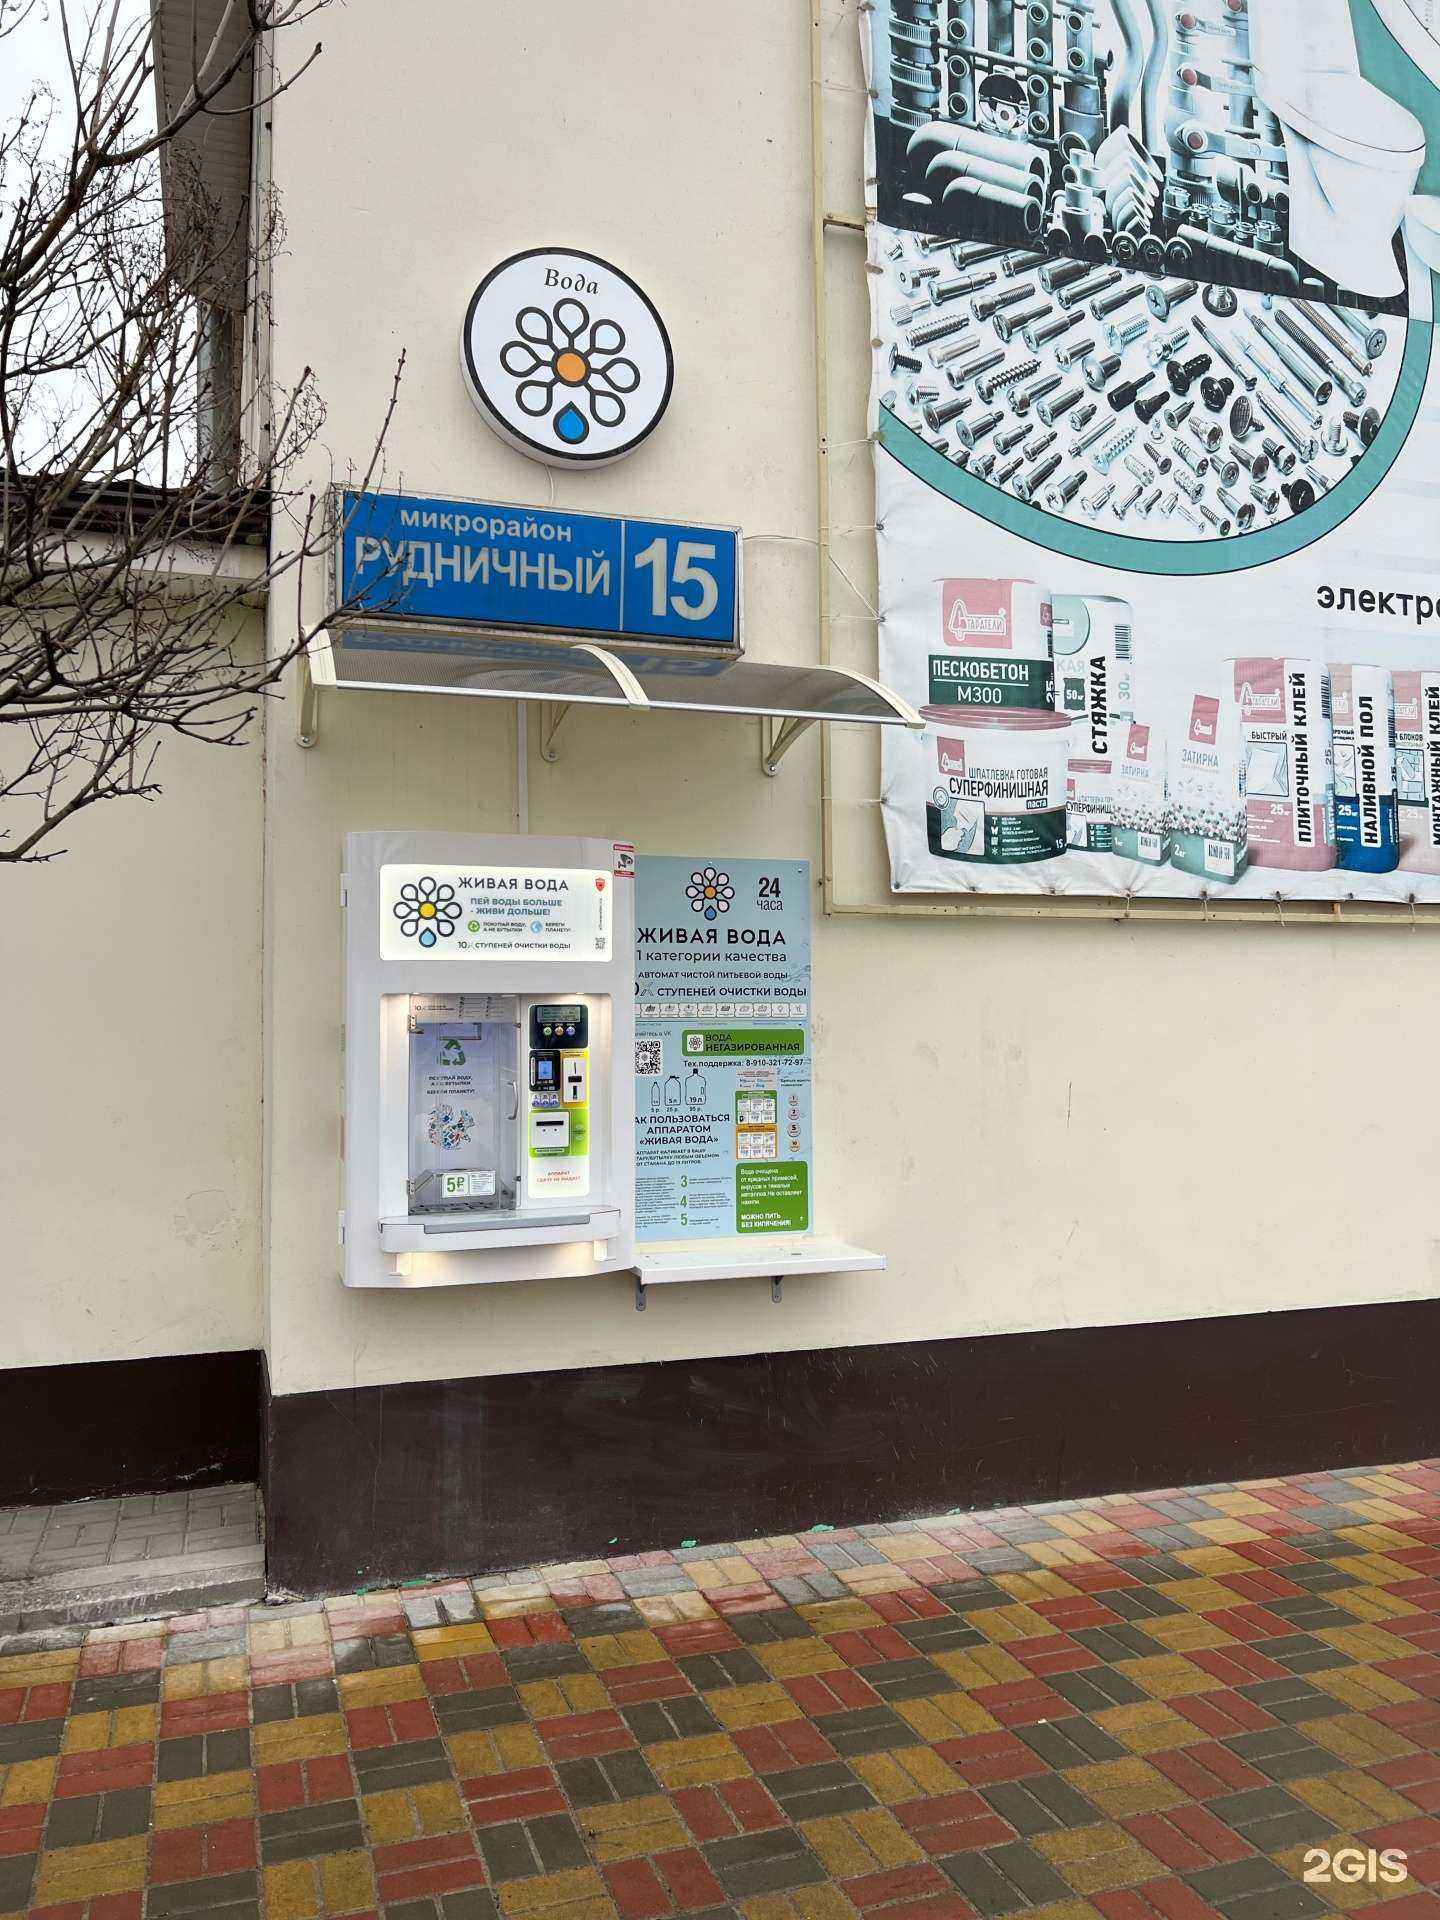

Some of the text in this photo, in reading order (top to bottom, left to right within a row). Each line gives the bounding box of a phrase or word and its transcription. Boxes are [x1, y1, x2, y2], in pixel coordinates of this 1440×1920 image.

[544, 267, 599, 295] Вода
[400, 508, 573, 543] микрорайон
[354, 536, 720, 622] РУДНИЧНЫЙ 15
[1317, 585, 1440, 625] электр
[932, 659, 1029, 681] ПЕСКОБЕТОН
[957, 685, 1002, 704] М300
[1089, 655, 1108, 754] СТЯЖКА
[1424, 686, 1440, 735] КЛЕЙ
[1251, 730, 1287, 741] БЫСТРЫЙ
[1289, 673, 1312, 843] ПЛИТОЧНЫЙ КЛЕЙ
[1016, 766, 1048, 780] ГОТОВАЯ
[1357, 696, 1378, 844] НАЛИВНОЙ ПОЛ
[949, 777, 1049, 799] СУПЕРФИНИШНАЯ
[458, 876, 569, 893] ЖИВАЯ ВОДА
[758, 877, 781, 898] 24
[470, 896, 563, 907] ПЕЙ ВОДЫ БОЛЬШЕ
[756, 899, 784, 911] часа
[476, 907, 505, 915] ЖИВИ
[637, 927, 786, 948] ЖИВАЯ ВОДА
[550, 942, 571, 950] ВОДЫ
[646, 952, 721, 964] категории
[725, 952, 787, 962] качества
[638, 970, 788, 980] АВТОМАТ ЧИСТОЙ ПИТЬЕВОЙ ВОДЫ
[657, 985, 807, 997] СТУПЕНЕЙ ОЧИСТКИ ВОДЫ
[705, 1034, 732, 1042] ВОДА
[705, 1043, 800, 1052] НЕГАЗИРОВАННАЯ
[650, 1114, 730, 1124] ПОЛЬЗОВАТЬСЯ
[646, 1125, 711, 1134] АППАРАТОМ
[639, 1135, 719, 1145] «ЖИВАЯ ВОДА»
[680, 1175, 688, 1188] 3
[680, 1195, 688, 1208] 4
[680, 1213, 688, 1226] 5
